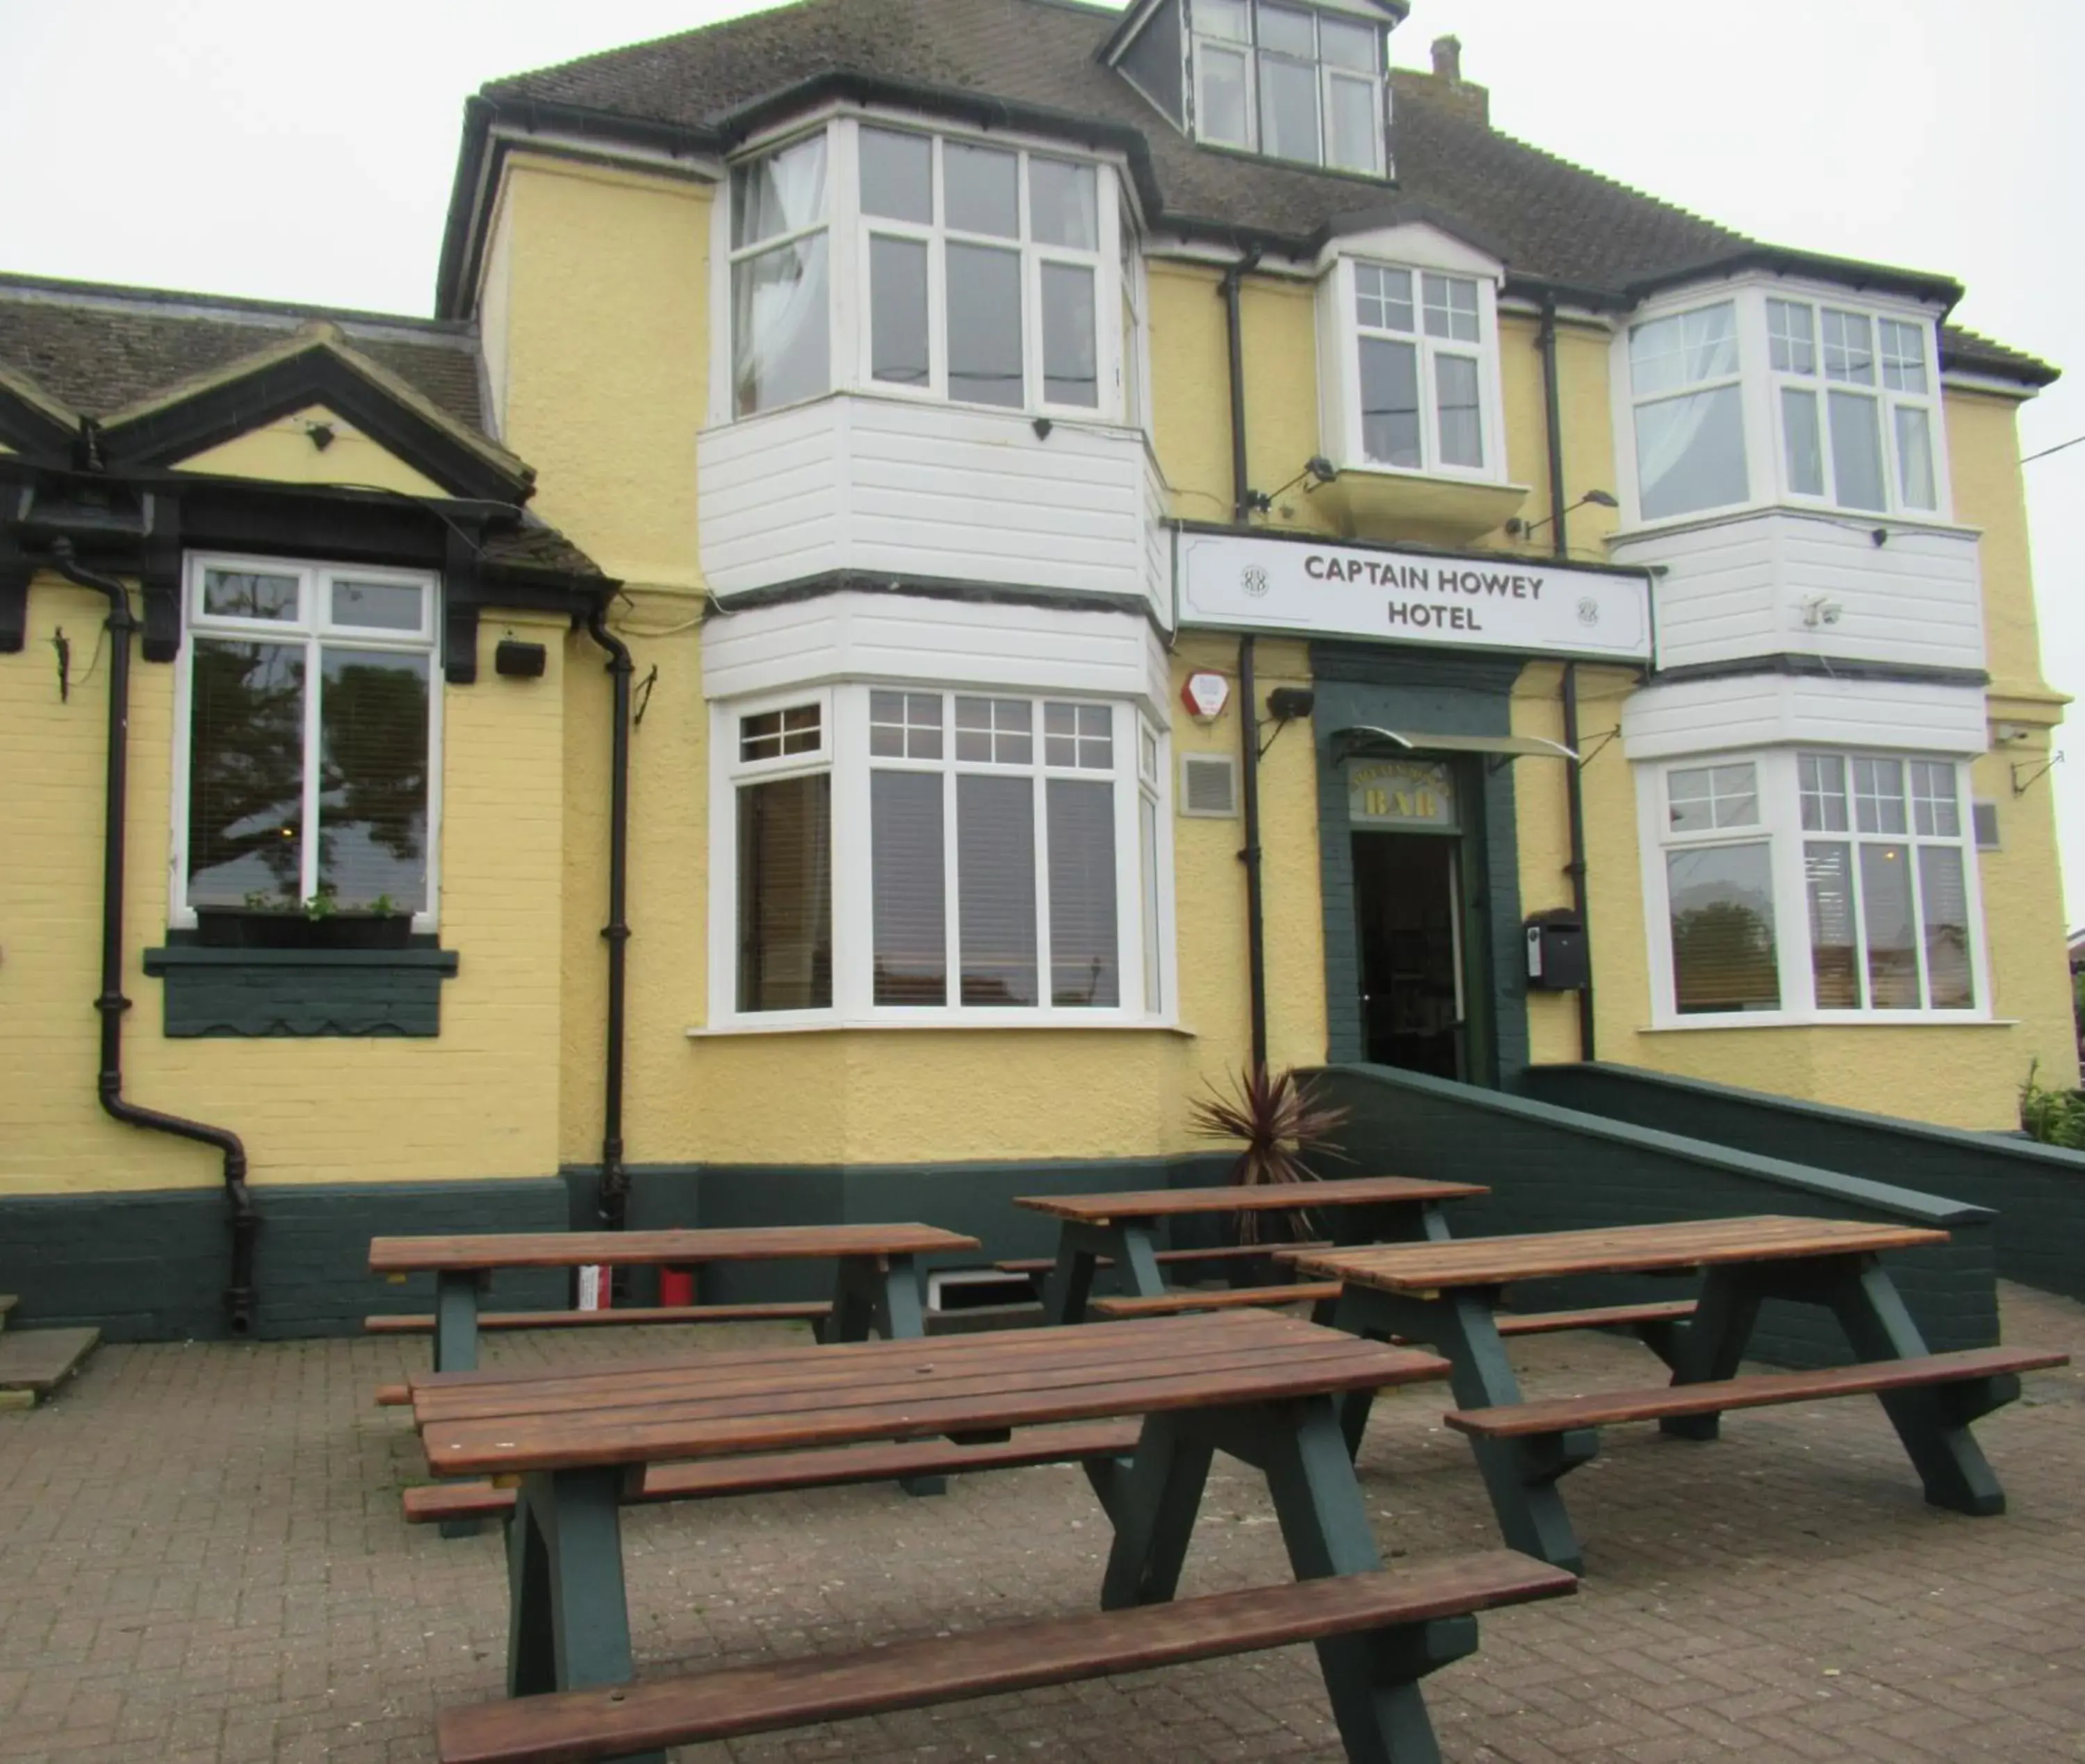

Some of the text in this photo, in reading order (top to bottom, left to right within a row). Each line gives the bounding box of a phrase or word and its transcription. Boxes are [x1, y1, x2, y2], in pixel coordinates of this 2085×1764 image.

[1305, 555, 1544, 600] CAPTAIN HOWEY
[1389, 601, 1482, 630] HOTEL
[1365, 787, 1437, 817] BAR
